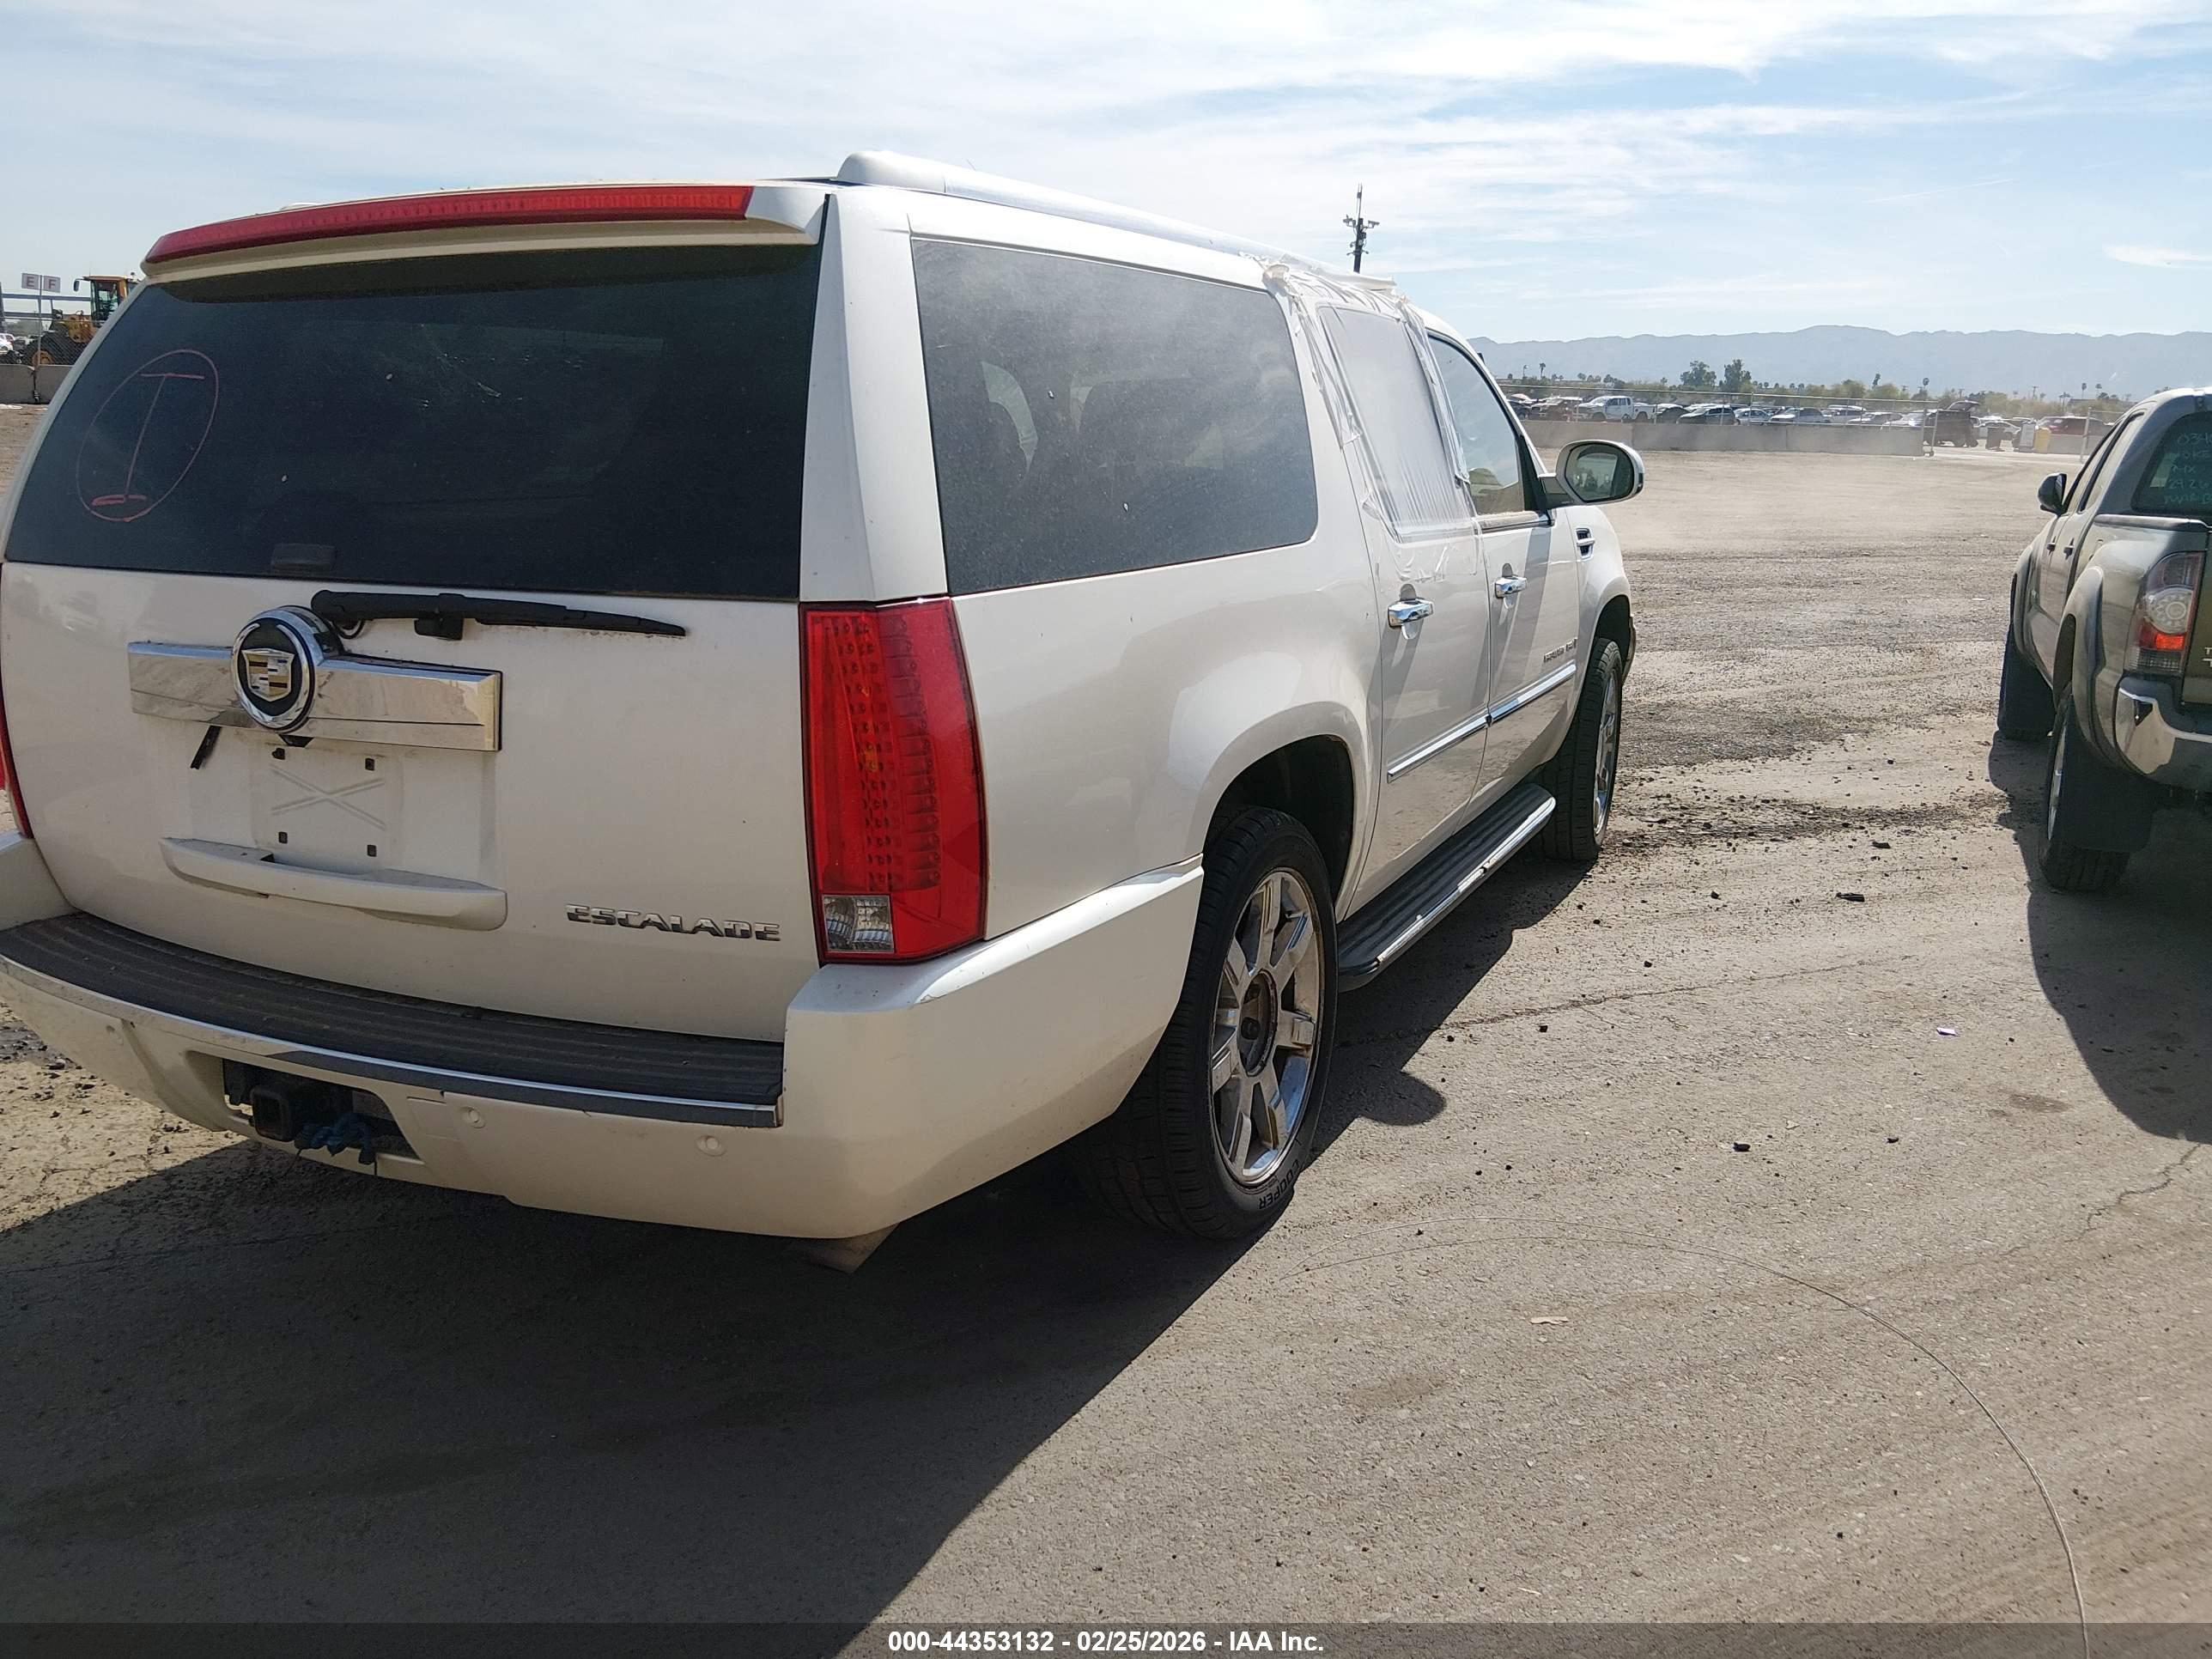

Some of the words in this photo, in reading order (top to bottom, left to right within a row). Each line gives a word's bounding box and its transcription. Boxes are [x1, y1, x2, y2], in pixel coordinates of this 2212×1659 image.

[26, 276, 35, 288] E
[48, 278, 57, 289] F
[565, 902, 782, 942] ESCALADE
[1259, 1159, 1300, 1209] COOPER
